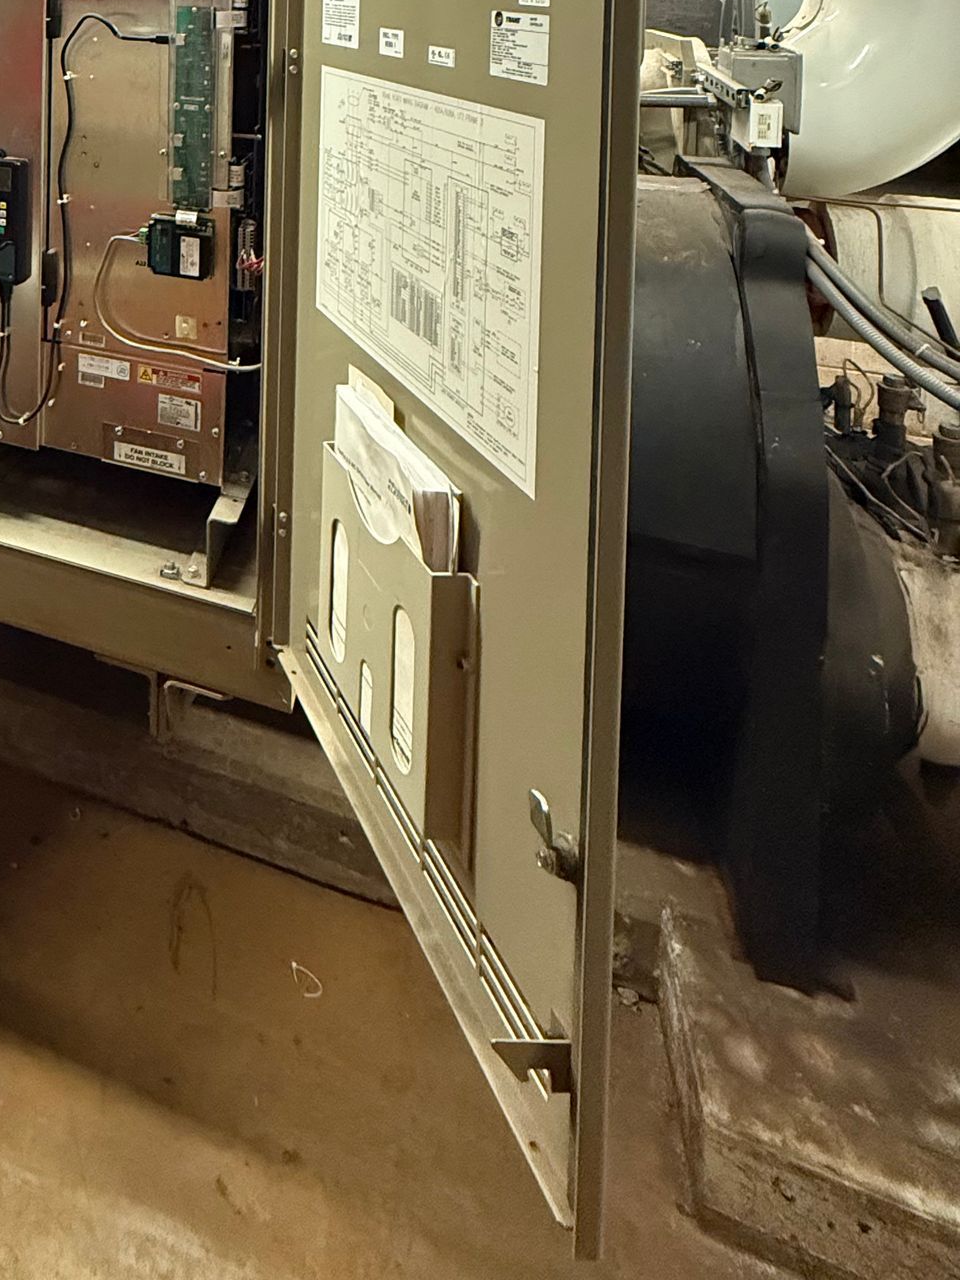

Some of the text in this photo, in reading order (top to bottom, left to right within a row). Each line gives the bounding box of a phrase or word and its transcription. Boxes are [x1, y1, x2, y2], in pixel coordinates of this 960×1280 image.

[130, 447, 168, 460] FAN INTAKE
[136, 455, 150, 464] NOT
[151, 459, 174, 469] BLOCK
